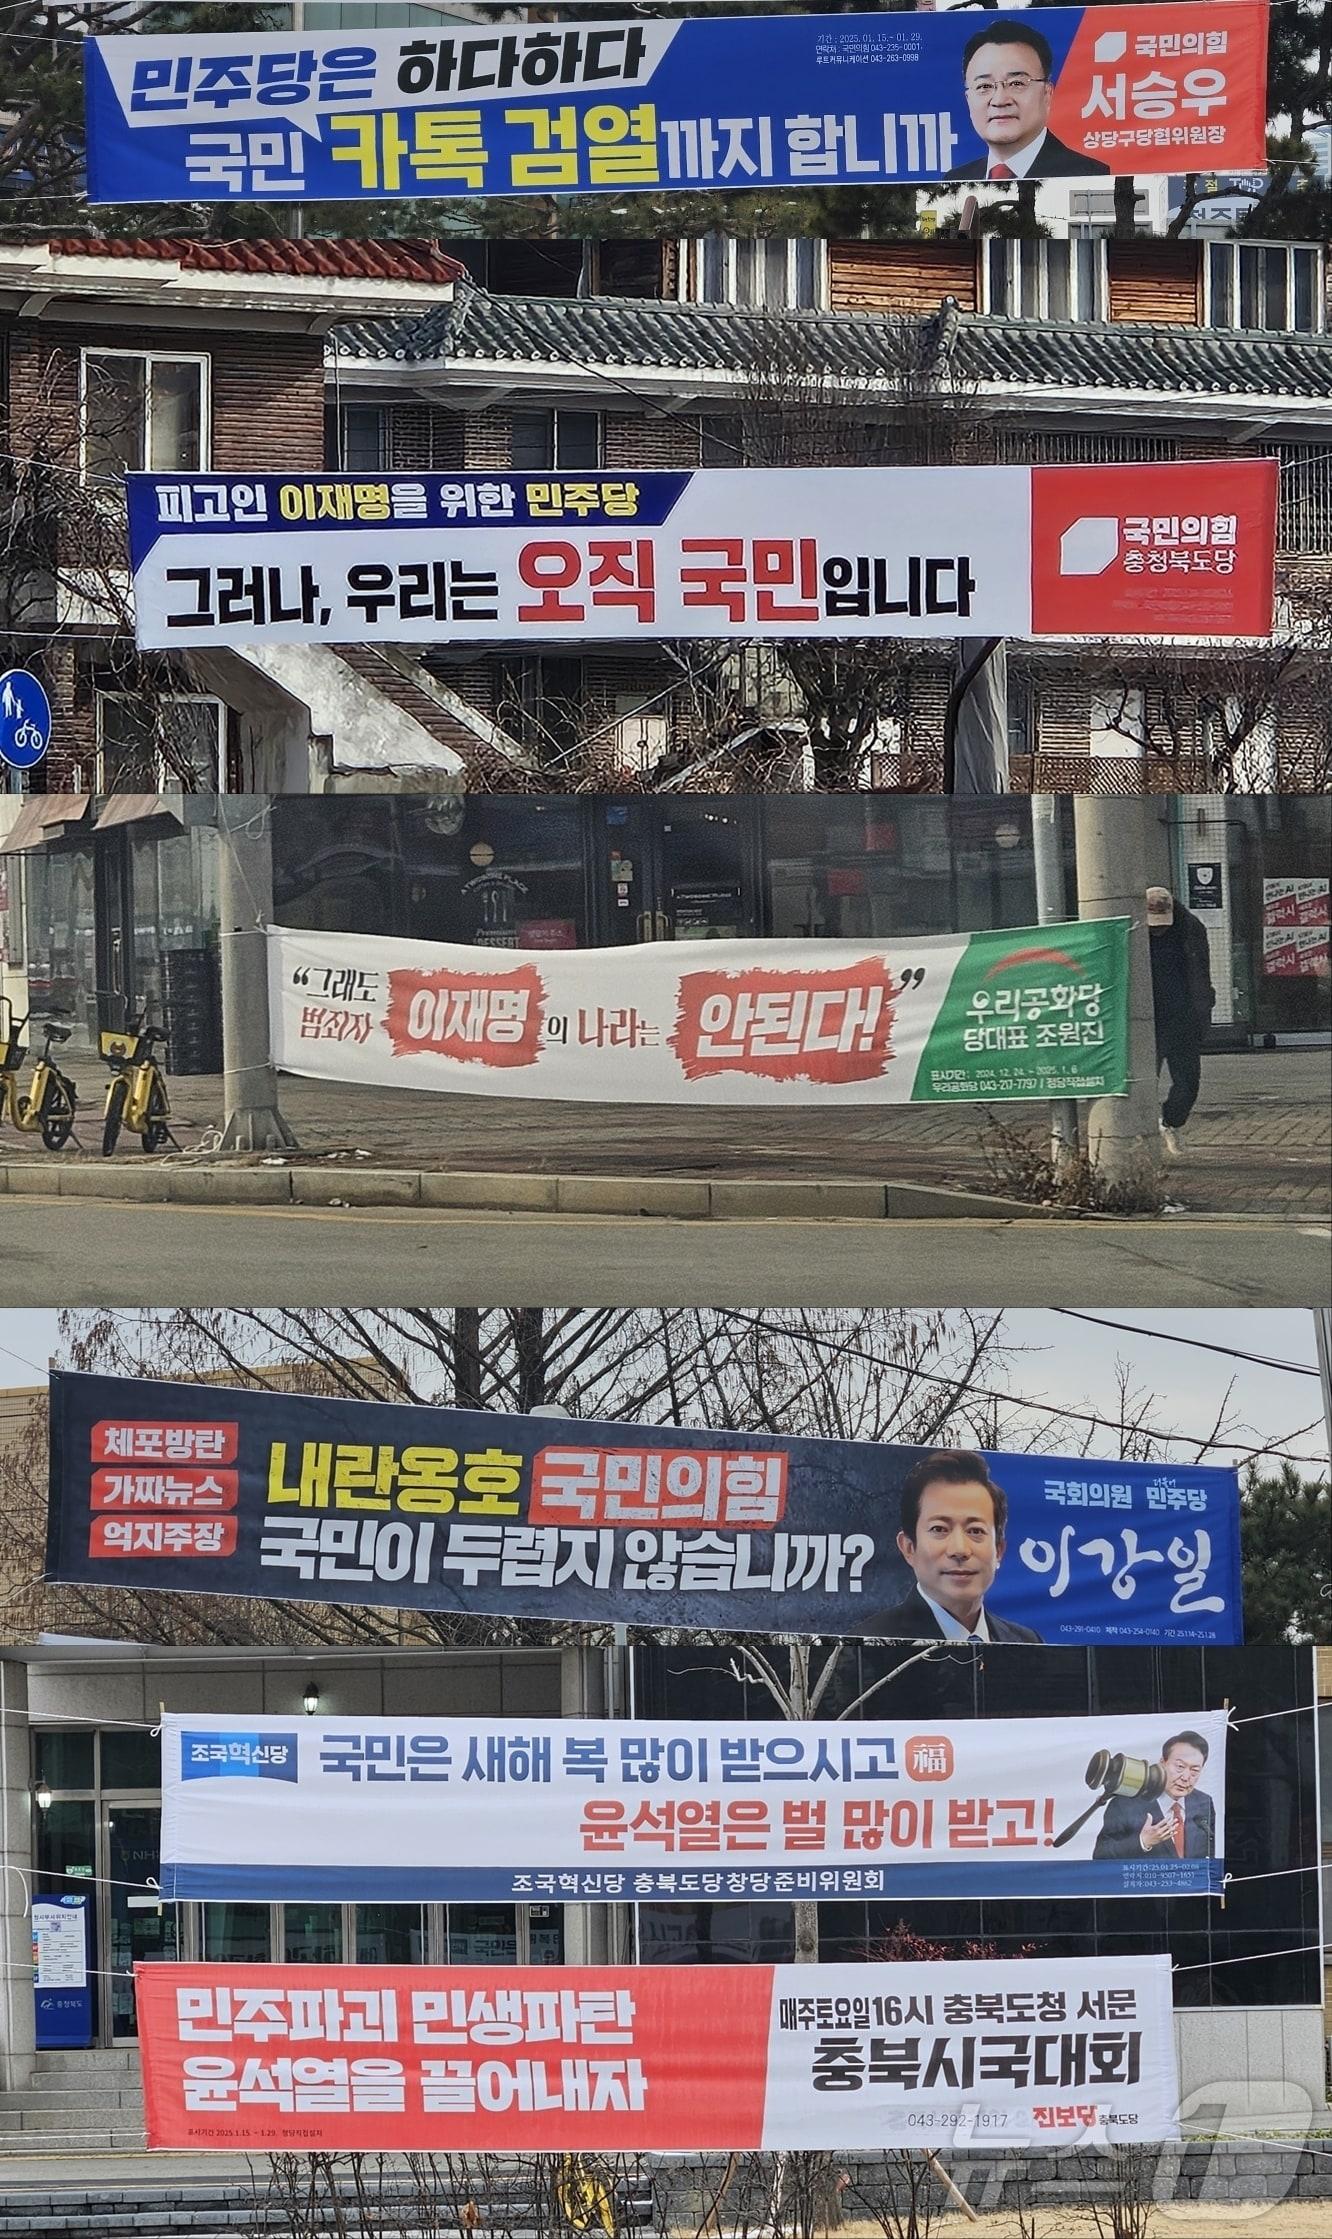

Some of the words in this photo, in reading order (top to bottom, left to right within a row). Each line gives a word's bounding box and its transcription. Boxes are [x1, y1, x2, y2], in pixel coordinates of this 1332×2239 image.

[842, 44, 871, 54] 국민의힘
[870, 53, 920, 63] 043-263-0998
[1135, 31, 1228, 57] 국민의힘
[130, 46, 377, 113] 민주당은
[397, 26, 646, 94] 하다하다
[1081, 68, 1227, 120] 서승우
[184, 131, 306, 192] 국민
[330, 109, 489, 191] 카톡
[783, 110, 958, 177] 합니까
[155, 483, 268, 522] 피고인
[280, 483, 429, 523] 이재명을
[441, 483, 515, 519] 위한
[526, 482, 640, 518] 민주당
[1123, 515, 1237, 546] 국민의힘
[1123, 549, 1238, 575] 충청북도당
[165, 564, 333, 629] 그러나,
[346, 560, 499, 624] 우리는
[517, 539, 656, 624] 오직
[679, 537, 976, 623] 국민입니다
[966, 983, 1102, 1025] 우리공화당
[300, 1005, 374, 1045] 범죄자
[577, 1006, 660, 1048] 나라는
[963, 1025, 1030, 1052] 당대표
[1035, 1020, 1105, 1048] 조원진
[979, 1077, 1038, 1092] 043-217-7797
[103, 1427, 226, 1460] 체포방탄
[103, 1474, 224, 1507] 가짜뉴스
[266, 1441, 523, 1515] 내란옹호
[541, 1451, 781, 1522] 국민의힘
[1043, 1479, 1133, 1510] 국회의원
[1146, 1486, 1208, 1513] 민주당
[103, 1520, 225, 1553] 억지주장
[259, 1515, 435, 1585] 국민이
[442, 1521, 615, 1589] 두렵지
[622, 1529, 876, 1593] 않습니까?
[1018, 1525, 1226, 1614] 이강일
[191, 1742, 289, 1767] 조국혁신당
[319, 1733, 453, 1784] 국민은
[460, 1734, 552, 1785] 새해
[561, 1735, 609, 1784] 복
[619, 1736, 708, 1784] 많이
[719, 1736, 900, 1784] 받으시고
[911, 1741, 948, 1776] 福
[579, 1799, 772, 1853] 윤석열은
[783, 1799, 827, 1853] 벌
[842, 1797, 934, 1851] 많이
[946, 1796, 1056, 1850] 받고!
[511, 1873, 626, 1895] 조국혁신당
[176, 1986, 399, 2044] 민주파괴
[411, 1989, 637, 2046] 민생파탄
[943, 1989, 1067, 2026] 충북도청
[1076, 1988, 1137, 2021] 서문
[811, 2030, 1143, 2092] 충북시국대회
[182, 2056, 406, 2113] 윤석열을
[420, 2057, 648, 2113] 끌어내자
[906, 2112, 1009, 2129] 043-292-1917
[1031, 2104, 1099, 2129] 진보당
[1098, 2112, 1140, 2127] 충북도당
